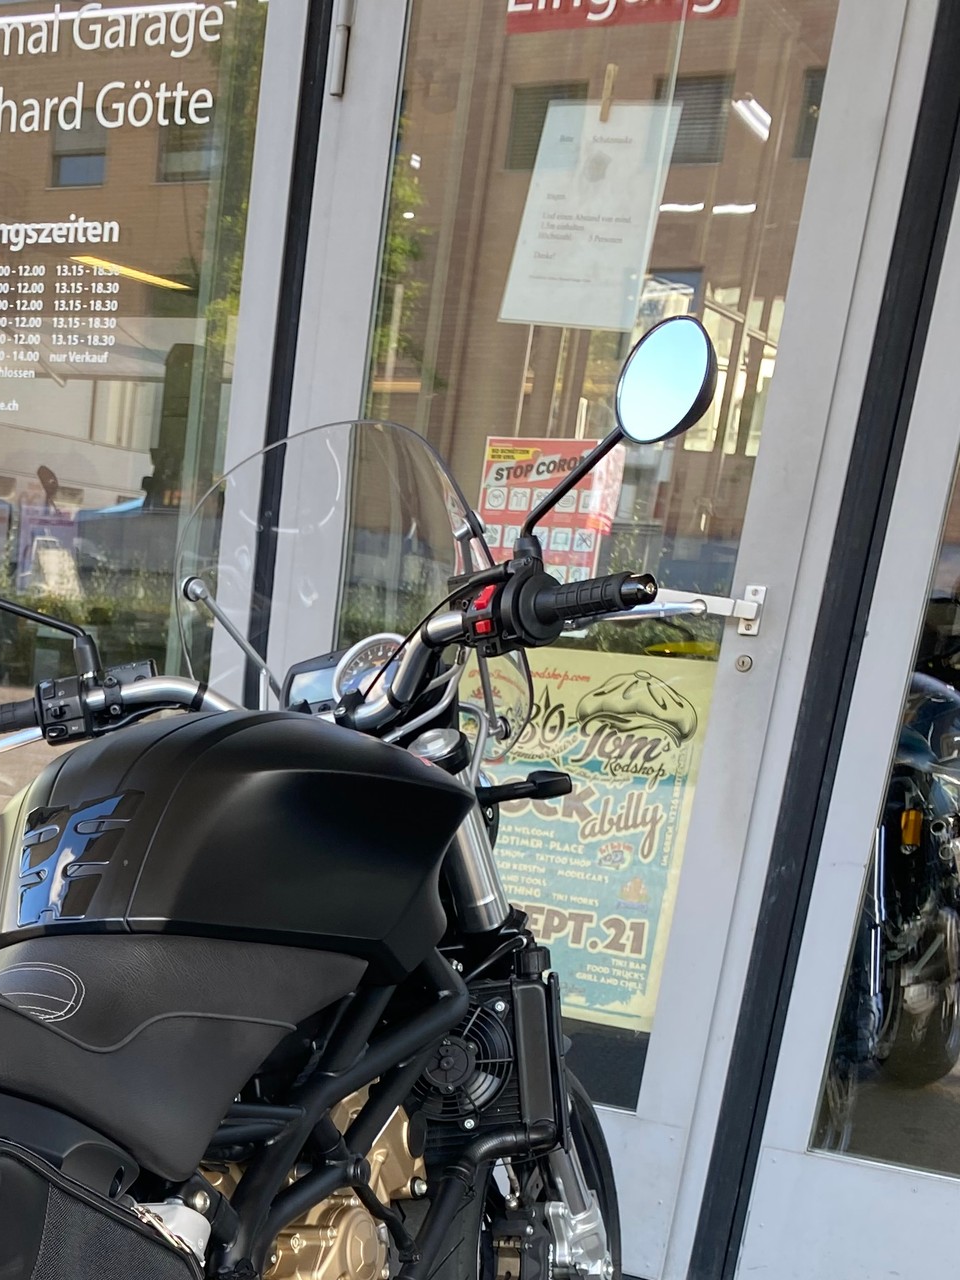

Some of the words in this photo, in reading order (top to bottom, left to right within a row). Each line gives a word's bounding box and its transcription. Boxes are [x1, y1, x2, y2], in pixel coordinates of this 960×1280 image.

[72, 2, 224, 58] Garage
[95, 80, 214, 129] Götte
[18, 265, 45, 276] 12.00
[56, 265, 84, 276] 13.15
[17, 282, 44, 294] 12.00
[55, 282, 83, 294] 13.15
[91, 282, 120, 294] 18.30
[16, 300, 43, 311] 12.00
[54, 300, 82, 311] 13.15
[90, 300, 118, 311] 18.30
[15, 317, 42, 328] 12.00
[53, 317, 80, 329] 13.15
[89, 317, 117, 329] 18.30
[14, 334, 40, 345] 12.00
[51, 334, 79, 346] 13.15
[87, 335, 115, 346] 18.30
[13, 351, 39, 362] 14.00
[49, 354, 66, 363] nur
[68, 352, 109, 363] Verkauf
[494, 463, 534, 481] STOP
[497, 836, 543, 849] LDTIMER
[549, 841, 586, 854] PLACE
[611, 958, 627, 967] TIKI
[629, 961, 647, 970] BAR
[586, 964, 610, 974] FOOD
[612, 968, 645, 980] TRUCKS
[575, 972, 598, 982] GRILL
[600, 977, 619, 986] AND
[620, 980, 643, 990] CHILL
